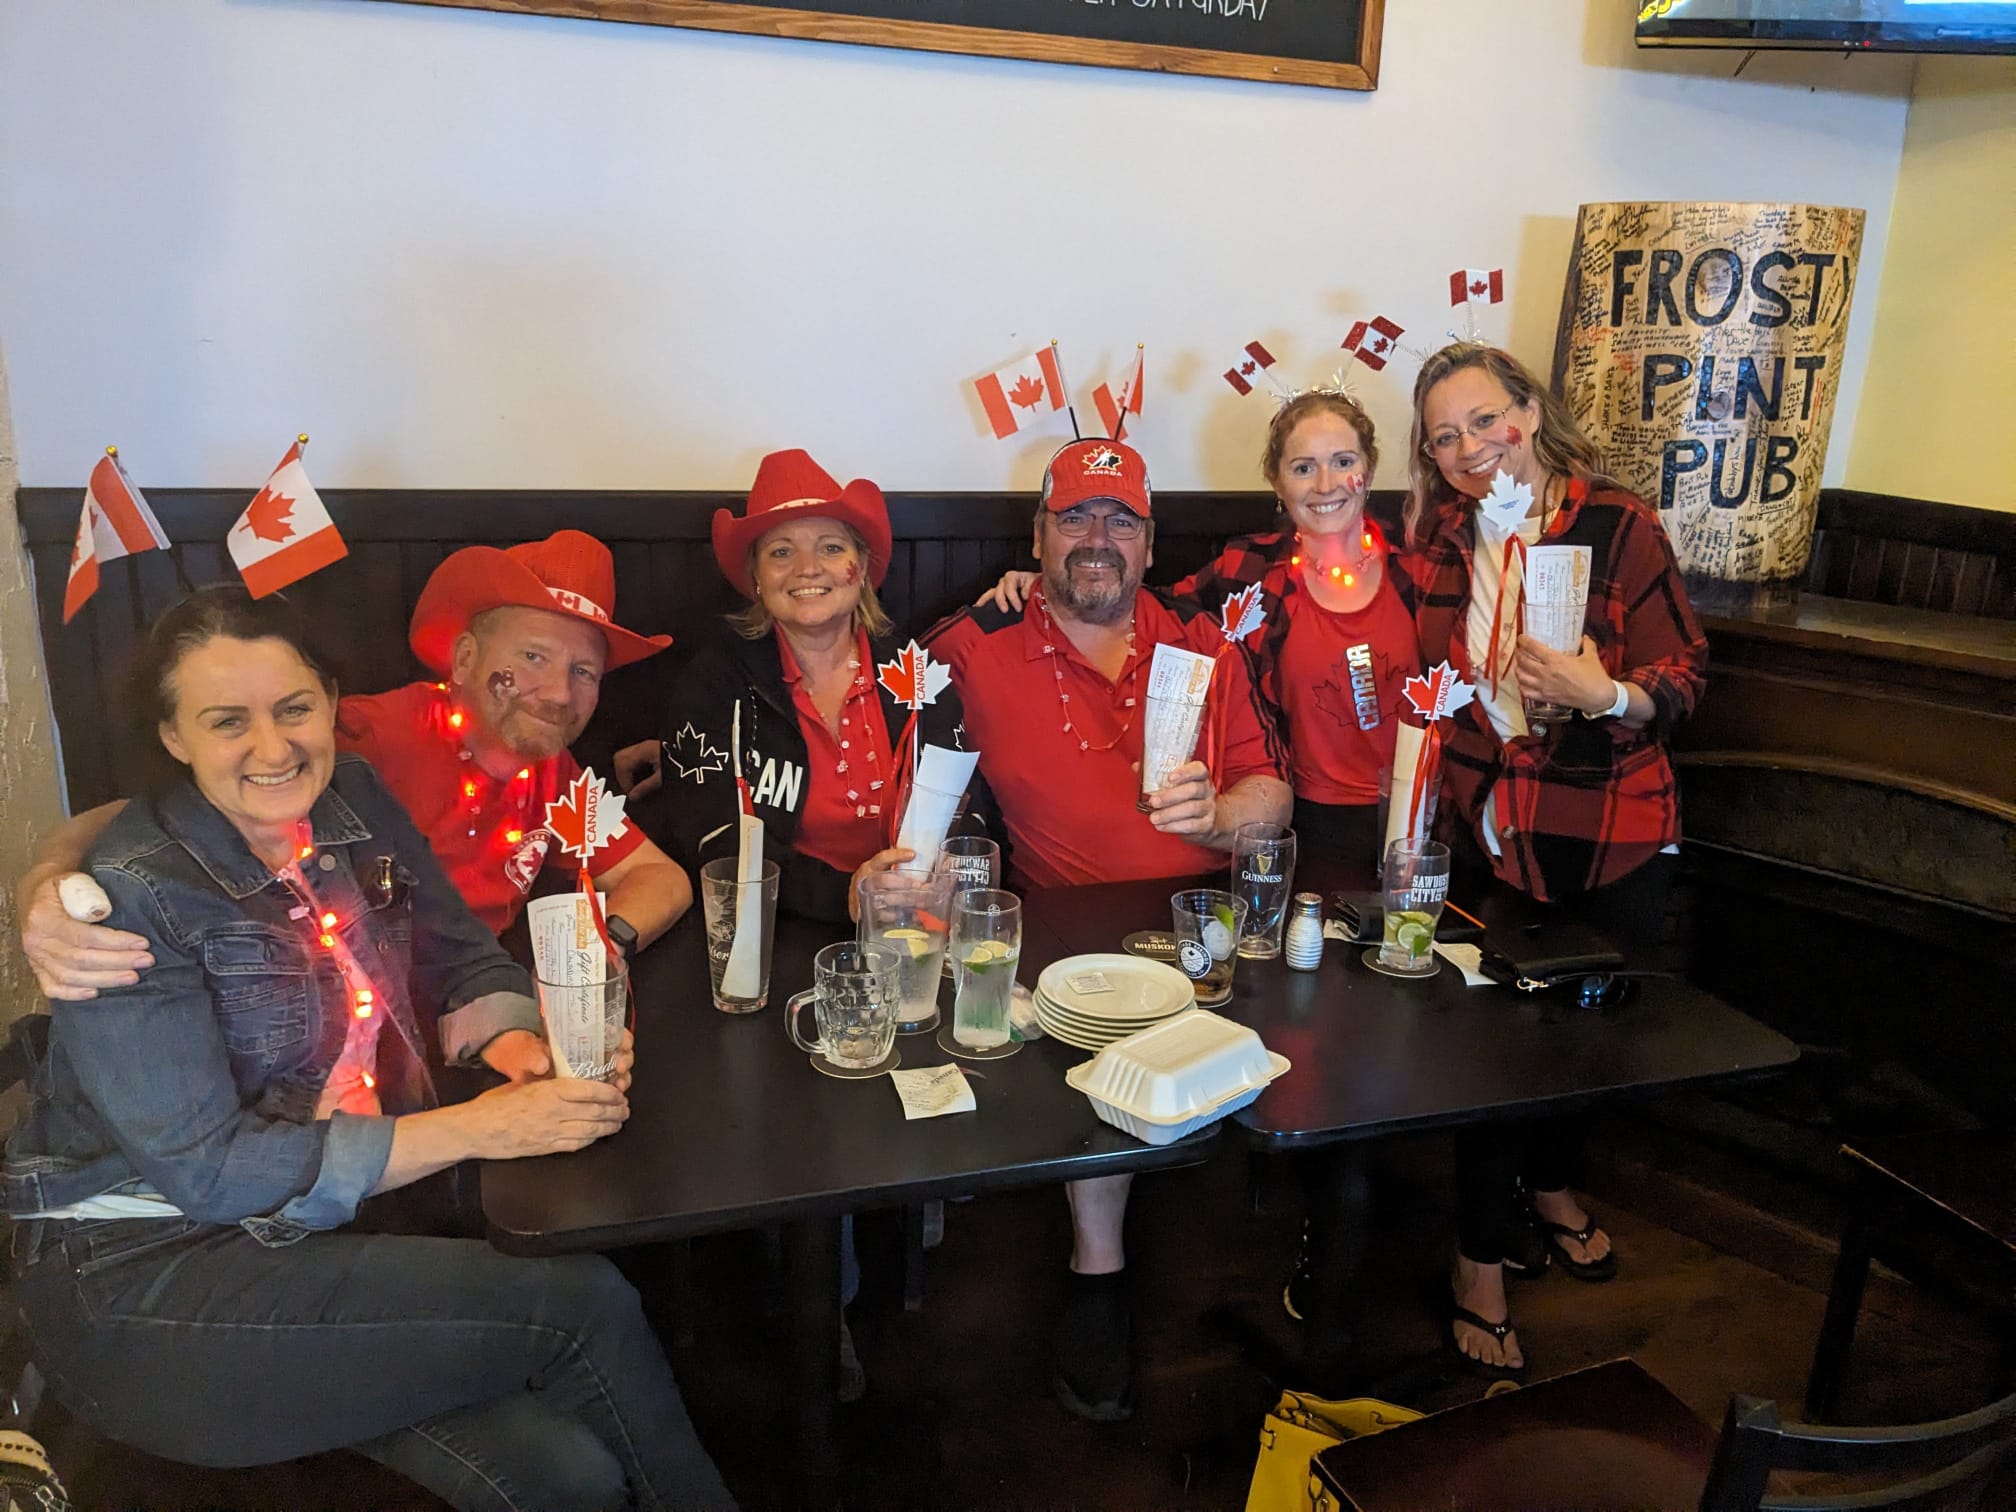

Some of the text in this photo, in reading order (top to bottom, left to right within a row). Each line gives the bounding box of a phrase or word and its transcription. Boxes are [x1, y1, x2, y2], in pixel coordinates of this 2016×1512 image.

[1131, 0, 1268, 21] RDAY
[1609, 247, 1852, 329] FROSTY
[1640, 353, 1826, 422] PINT
[1082, 469, 1123, 477] CANADA
[1659, 436, 1799, 509] PUB
[1236, 597, 1258, 635] CANADA
[916, 655, 926, 700] CANADA
[1346, 643, 1381, 731] CANADA
[1436, 674, 1452, 712] CANADA
[586, 785, 599, 843] CANADA
[1241, 870, 1282, 883] GUINNESS
[1410, 888, 1436, 903] CITY
[579, 951, 593, 977] Gift
[1134, 942, 1176, 951] MUSKO
[569, 1054, 617, 1079] Bud
